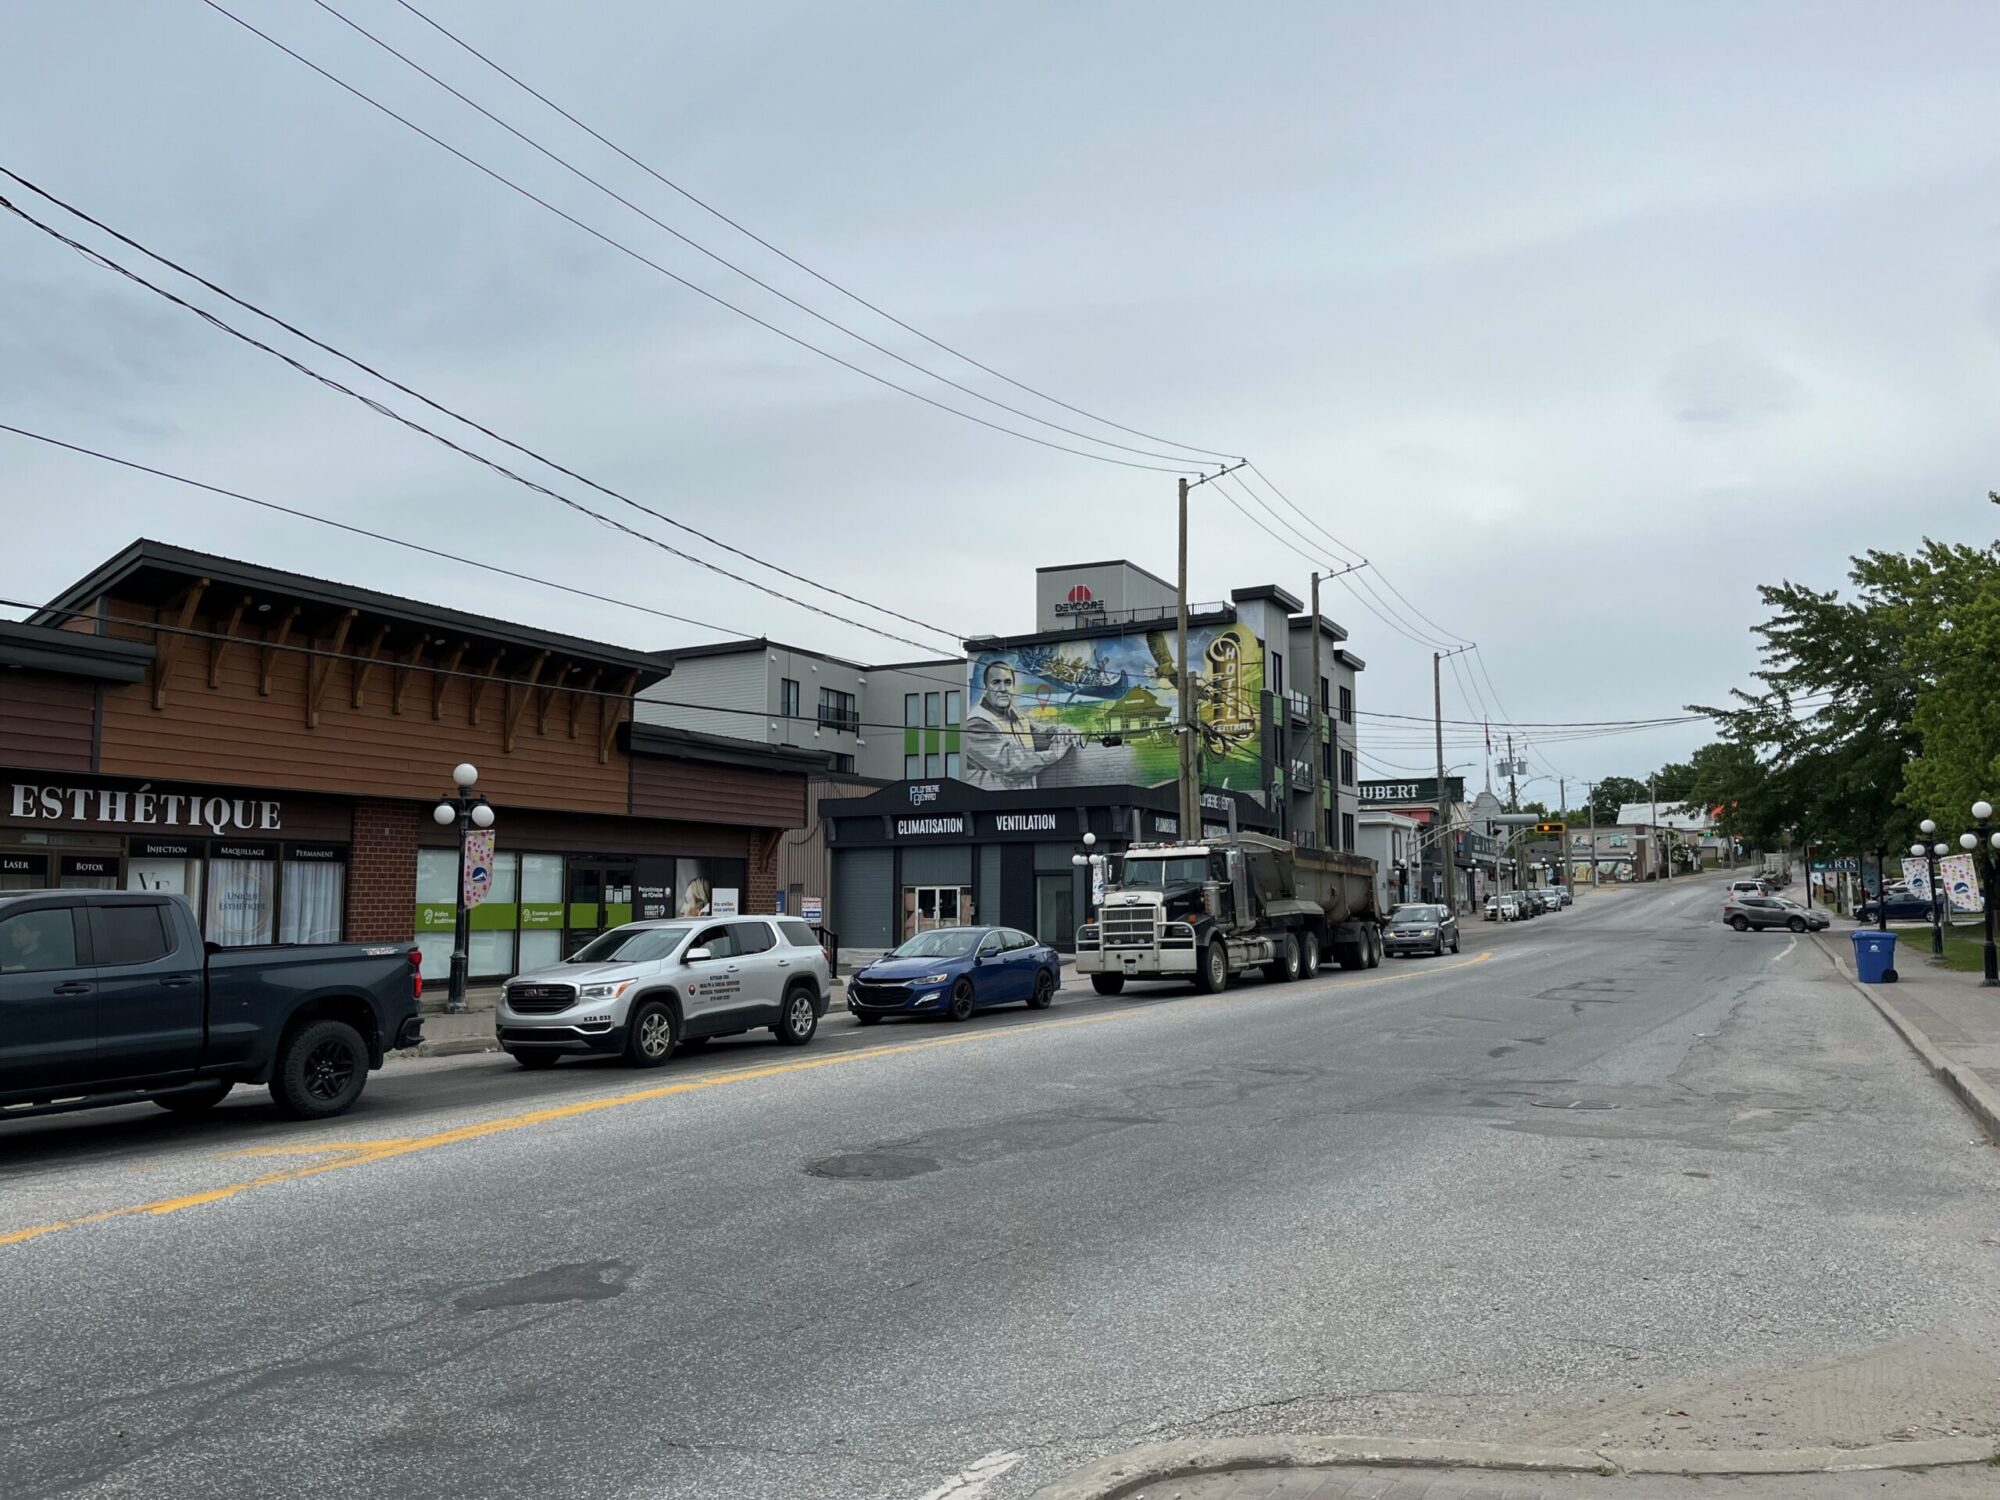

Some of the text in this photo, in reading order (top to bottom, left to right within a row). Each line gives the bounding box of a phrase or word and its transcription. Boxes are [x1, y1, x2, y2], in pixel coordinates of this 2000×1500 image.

[1055, 600, 1104, 612] DEVCORE
[9, 783, 281, 835] ESTHÉTIQUE
[898, 818, 963, 835] CLIMATISATION
[996, 814, 1056, 831] VENTILATION
[147, 844, 187, 854] INJECTION
[220, 847, 265, 857] MAQUILLAGE
[295, 849, 334, 858] PERMANENT
[3, 859, 29, 869] LASER
[76, 862, 104, 872] BOTOX
